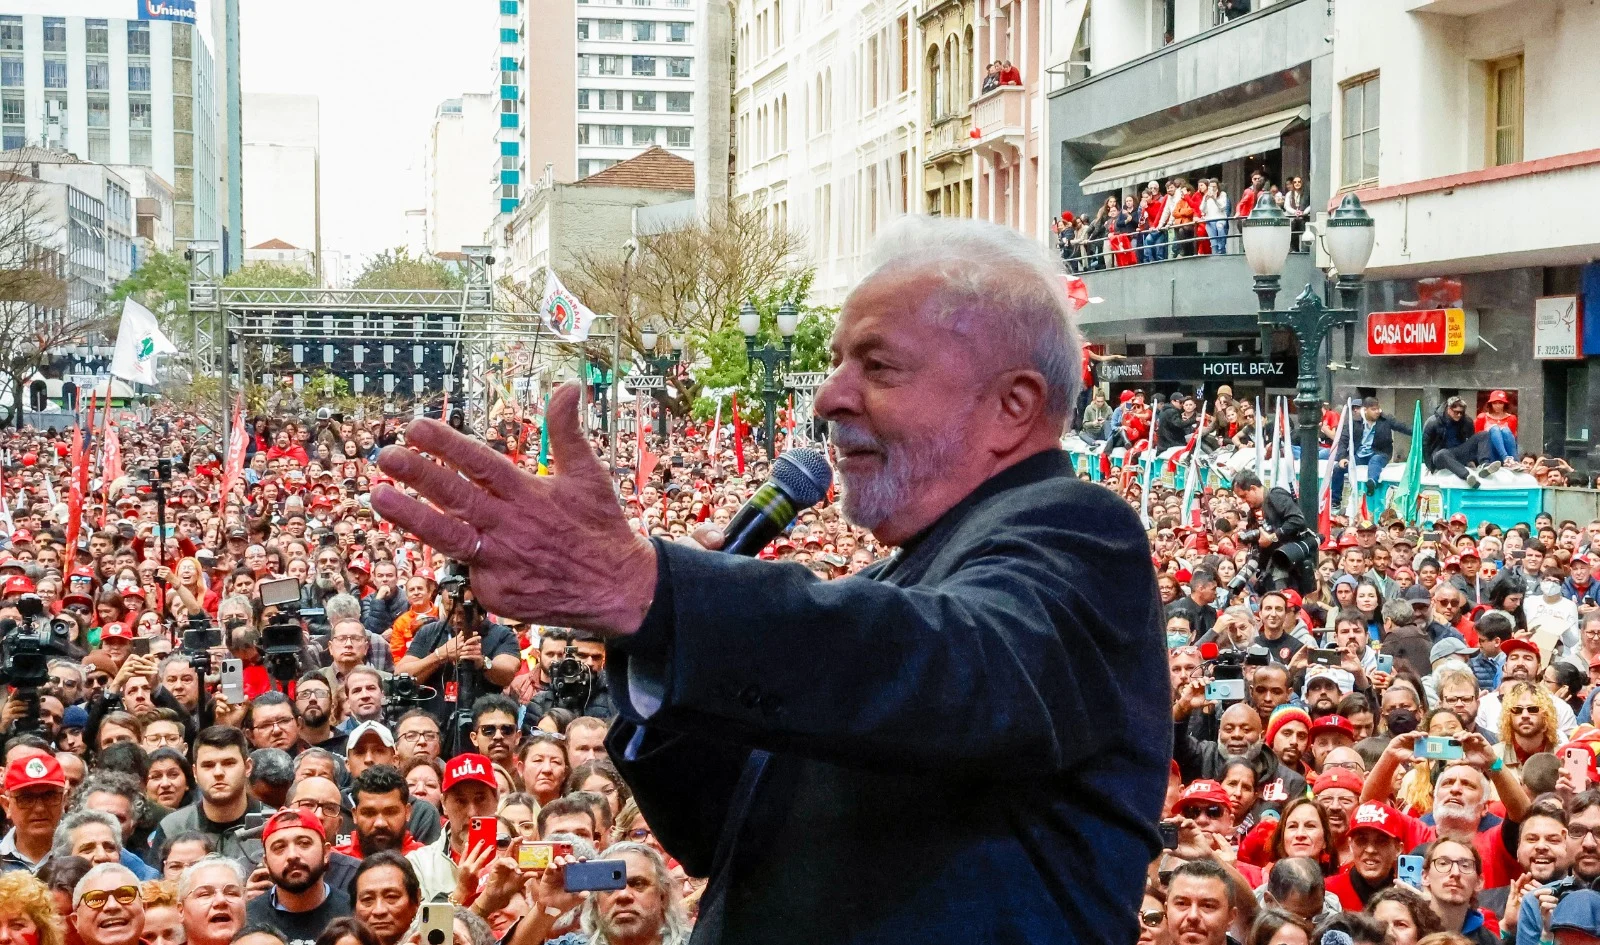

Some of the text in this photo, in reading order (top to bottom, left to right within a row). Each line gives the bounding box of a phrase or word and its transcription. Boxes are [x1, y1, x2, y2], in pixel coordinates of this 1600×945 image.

[1373, 323, 1437, 344] CASA CHINA
[1203, 362, 1284, 375] HOTEL BRAZ
[451, 763, 485, 778] LULA
